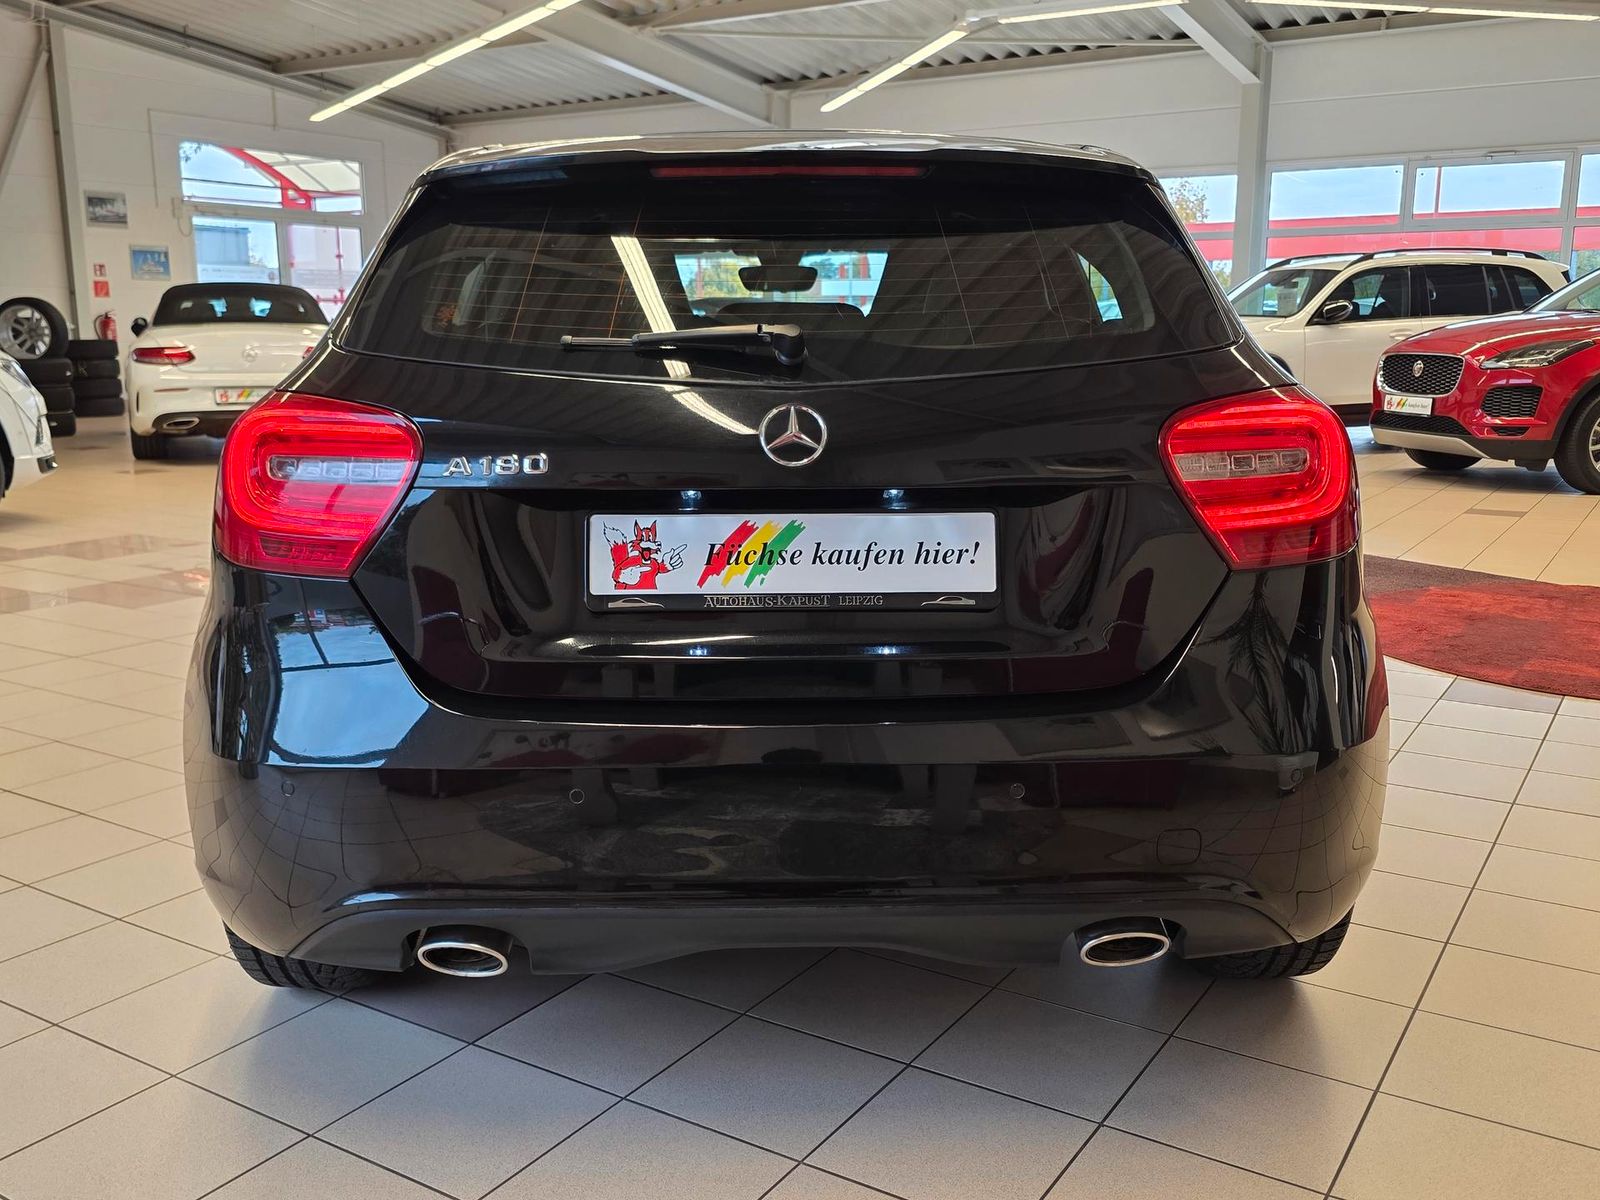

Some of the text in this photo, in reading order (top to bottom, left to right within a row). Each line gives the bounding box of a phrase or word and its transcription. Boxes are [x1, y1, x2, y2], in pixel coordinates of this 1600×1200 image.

[443, 453, 549, 476] A 180
[704, 541, 980, 571] Füchse kaufen hier!
[838, 595, 884, 606] LEIPZIG
